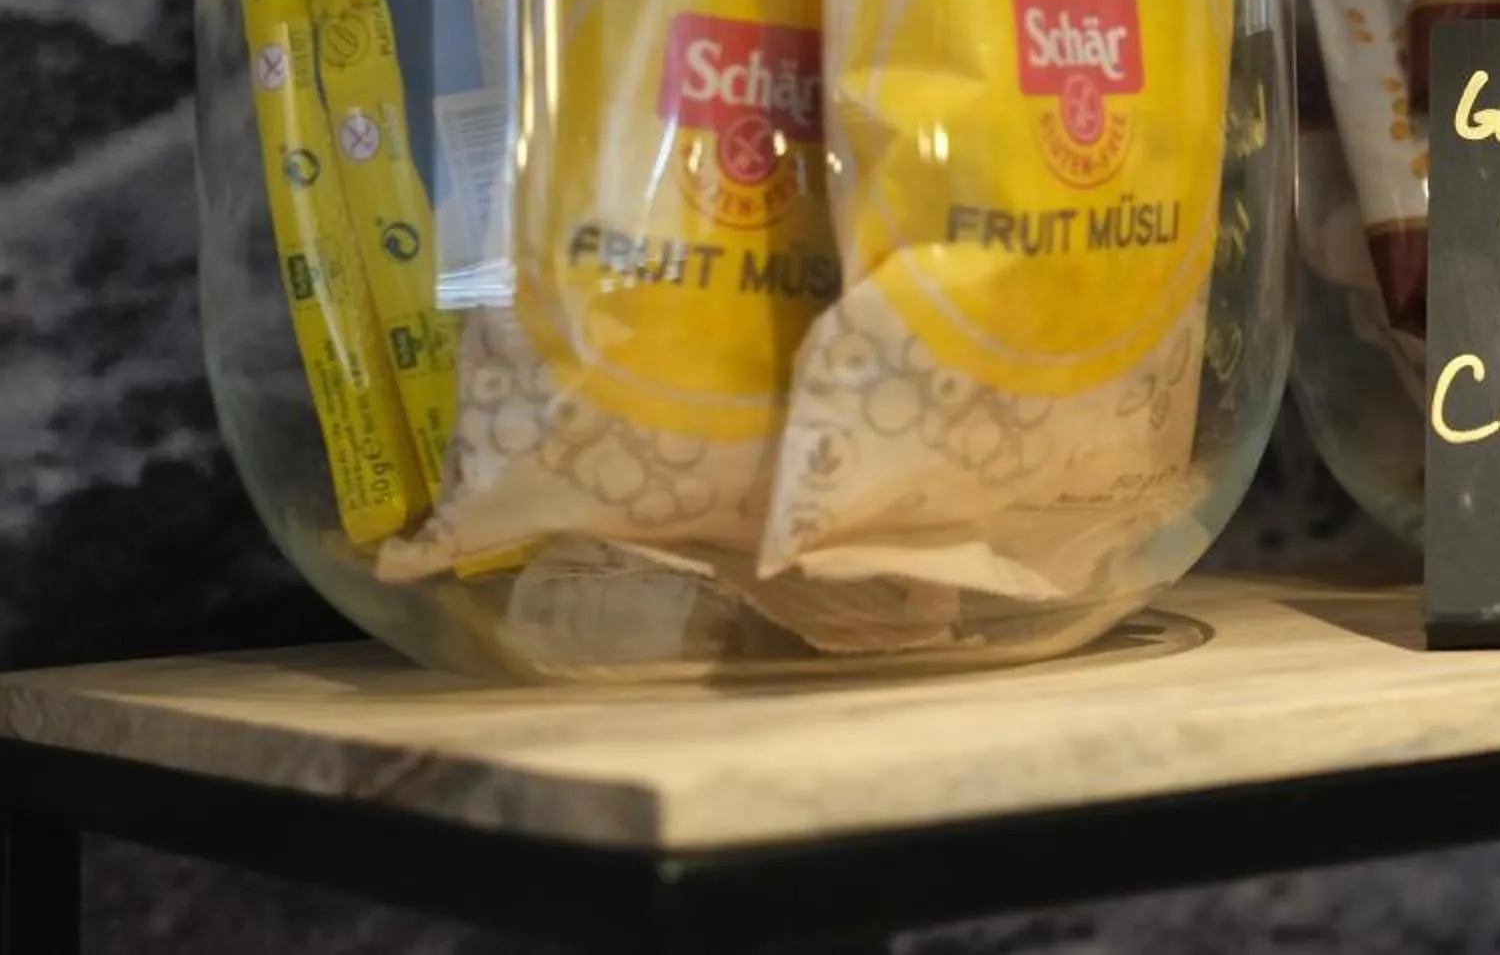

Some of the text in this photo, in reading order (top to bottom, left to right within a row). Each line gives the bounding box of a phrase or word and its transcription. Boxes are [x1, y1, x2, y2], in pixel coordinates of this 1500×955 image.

[1024, 6, 1128, 81] Schär
[568, 224, 726, 289] FRUIT
[946, 195, 1182, 257] FRUIT MÜSLI
